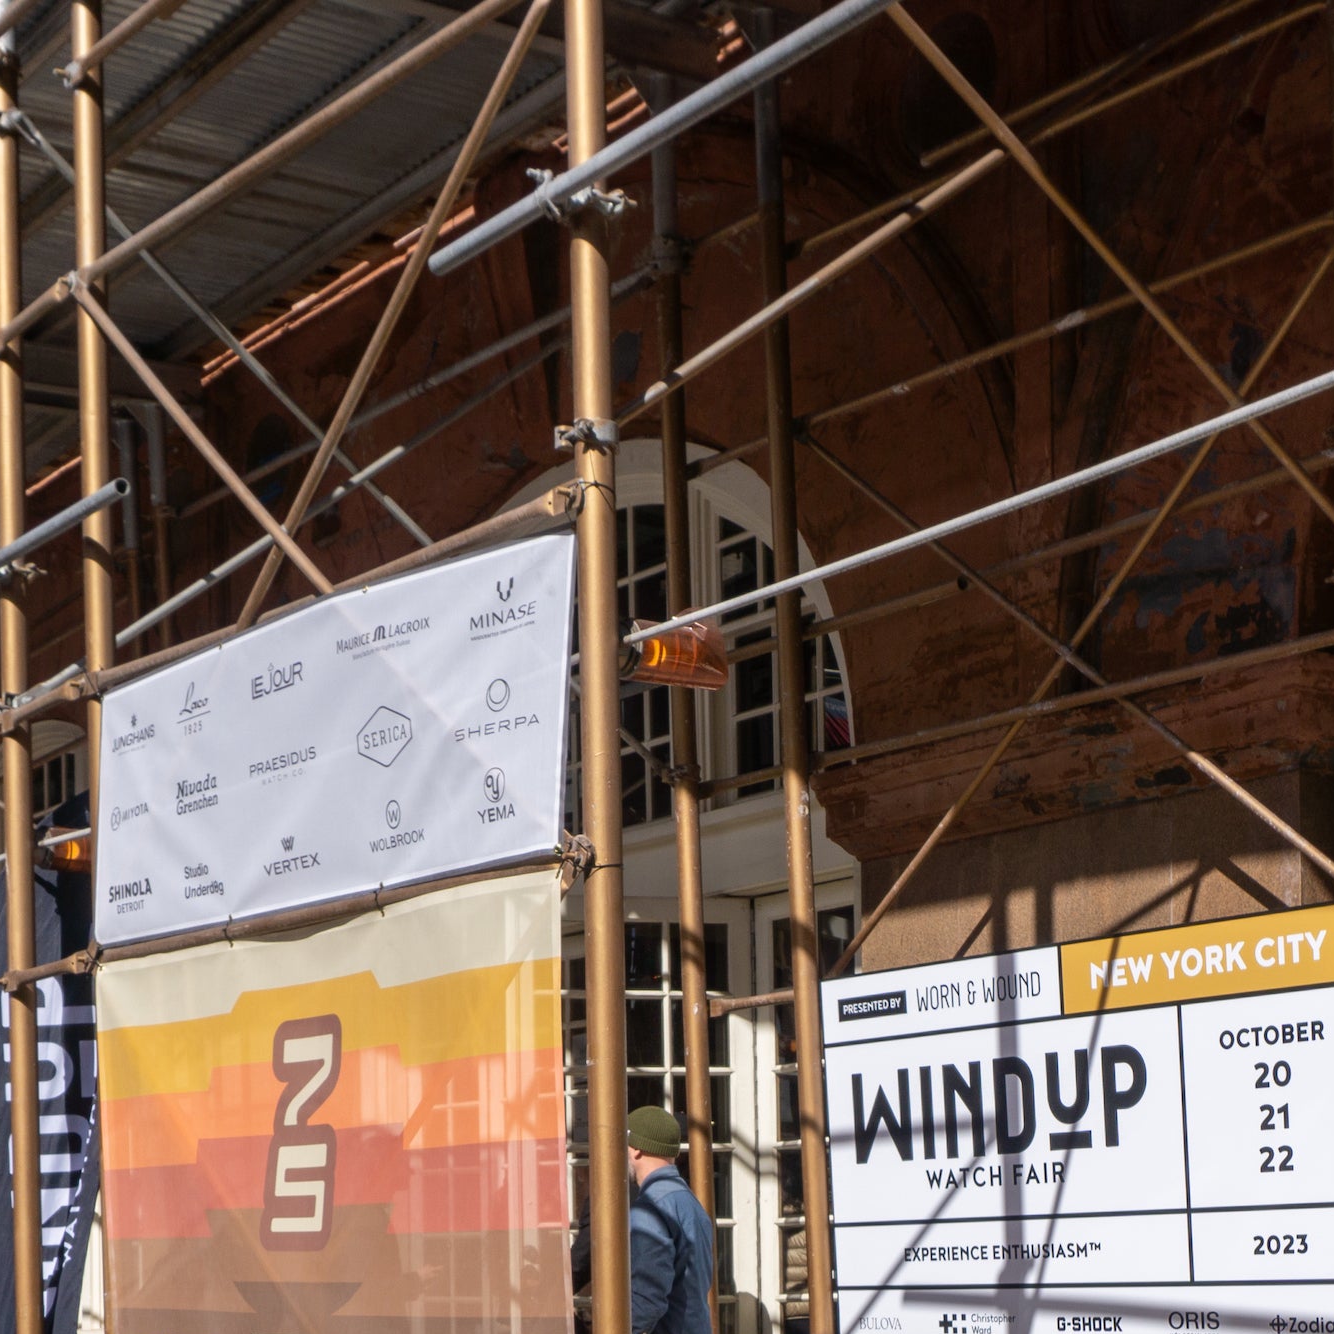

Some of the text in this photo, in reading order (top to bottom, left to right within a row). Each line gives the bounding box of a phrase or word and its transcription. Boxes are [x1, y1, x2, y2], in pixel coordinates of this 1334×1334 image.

[388, 616, 431, 638] LACROIX
[469, 600, 537, 631] MINASE
[112, 724, 156, 753] JUNGHANS
[183, 720, 203, 737] 1925
[363, 723, 408, 750] SERICA
[455, 713, 540, 742] SHERPA
[249, 746, 317, 778] PRAESIDUS
[176, 773, 218, 800] Nivada
[176, 793, 219, 816] Grenchen
[477, 803, 516, 825] YEMA
[369, 828, 426, 853] WOLBROOK
[184, 863, 209, 880] Studio
[263, 852, 321, 877] VERTEX
[109, 877, 153, 904] SHINOLA
[116, 899, 145, 915] DETROIT
[1090, 930, 1328, 991] NEW YORK CITY
[843, 971, 1041, 1016] PRESENTED BY WORN & WOUND
[1219, 1020, 1326, 1051] OCTOBER
[1253, 1061, 1292, 1090] 20
[851, 1043, 1148, 1165] WINDUP
[1259, 1103, 1291, 1132] 21
[1259, 1146, 1295, 1174] 22
[926, 1160, 1066, 1190] WATCH FAIR
[903, 1244, 989, 1263] EXPERIENCE
[1253, 1233, 1309, 1256] 2023
[859, 1316, 903, 1331] BULOVA
[971, 1313, 1016, 1325] Christopher
[1056, 1316, 1123, 1332] G-SHOCK
[1168, 1310, 1220, 1330] ORIS
